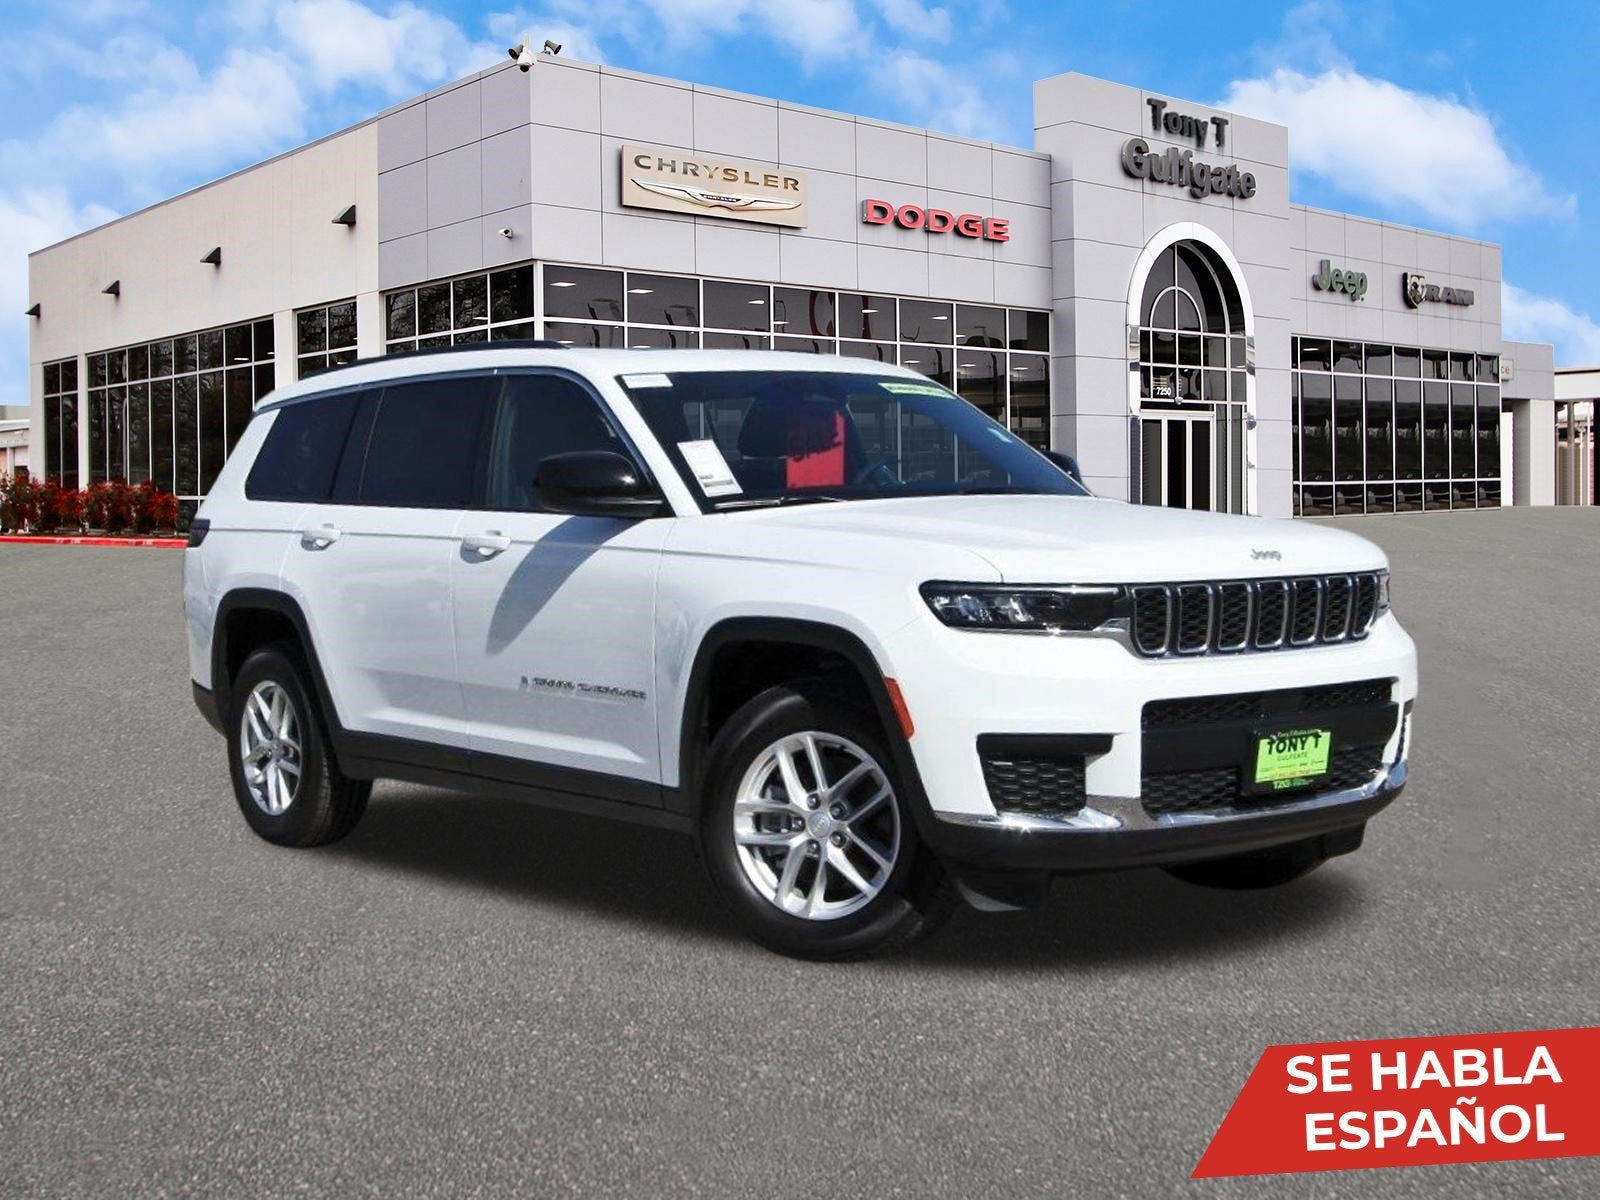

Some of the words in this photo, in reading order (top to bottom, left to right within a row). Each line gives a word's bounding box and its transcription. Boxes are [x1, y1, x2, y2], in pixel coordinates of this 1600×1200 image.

[1147, 98, 1208, 148] Tony
[1211, 116, 1229, 148] T
[633, 154, 801, 192] CHRYSLER
[1121, 137, 1257, 199] Gulfgate
[863, 199, 1011, 242] DODGE
[1312, 259, 1368, 301] Jeep
[1424, 284, 1474, 306] RAM
[1267, 735, 1310, 755] TONY
[1312, 732, 1322, 748] T
